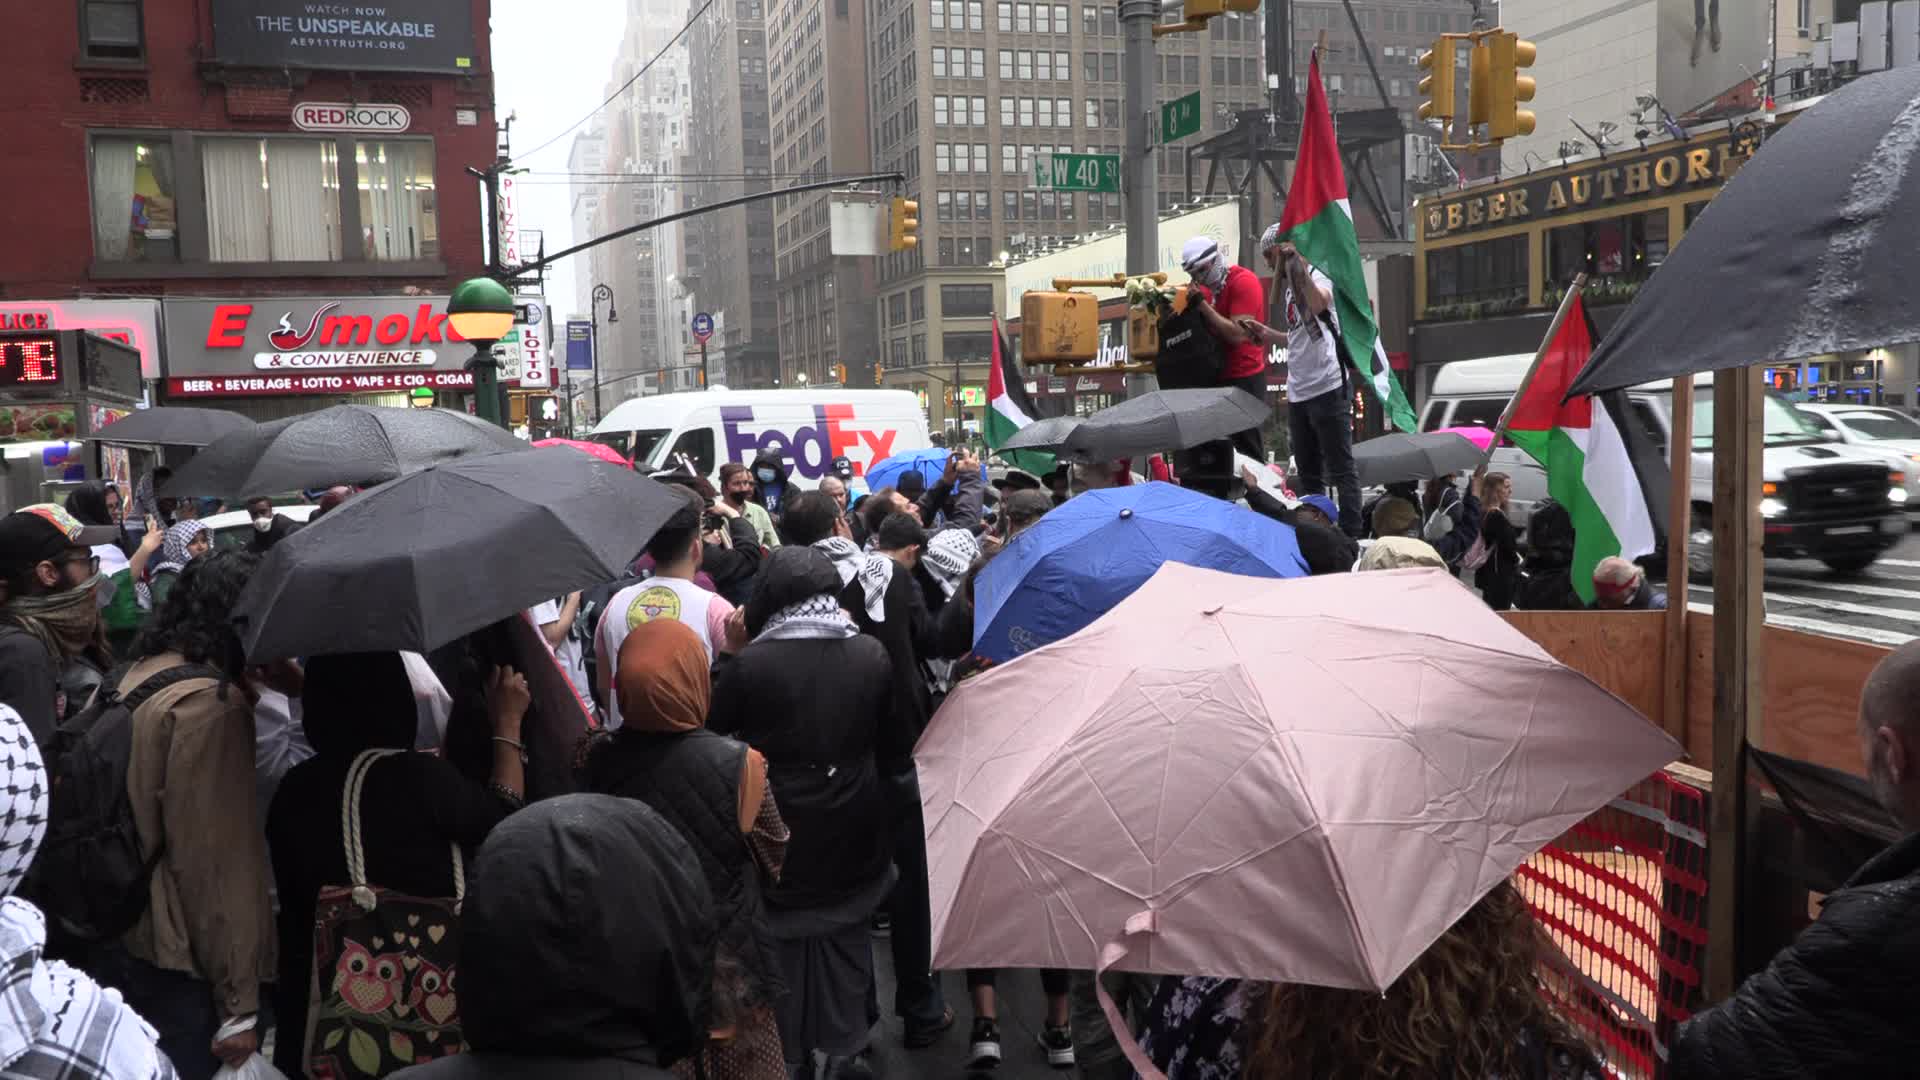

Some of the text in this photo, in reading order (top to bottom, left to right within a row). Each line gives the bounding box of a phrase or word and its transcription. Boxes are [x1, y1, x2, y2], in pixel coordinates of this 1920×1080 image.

[304, 5, 386, 16] WATCH NOW
[255, 15, 436, 38] THE UNSPEAKABLE
[290, 37, 406, 50] AE911TRUTH.ORG
[303, 109, 402, 126] REDROCK
[1169, 107, 1177, 136] 8
[1053, 158, 1117, 187] W 40 St
[503, 178, 517, 261] PIZZA
[1446, 189, 1529, 230] BEER
[269, 351, 422, 367] & CONVENIENCE
[524, 329, 543, 380] LOTTO
[183, 380, 214, 392] BEER
[224, 377, 291, 391] BEVERAGE
[302, 376, 342, 389] LOTTO
[353, 375, 384, 388] VAPE
[402, 375, 425, 387] CIG
[435, 373, 473, 386] CIGAR
[719, 404, 897, 480] FedEx
